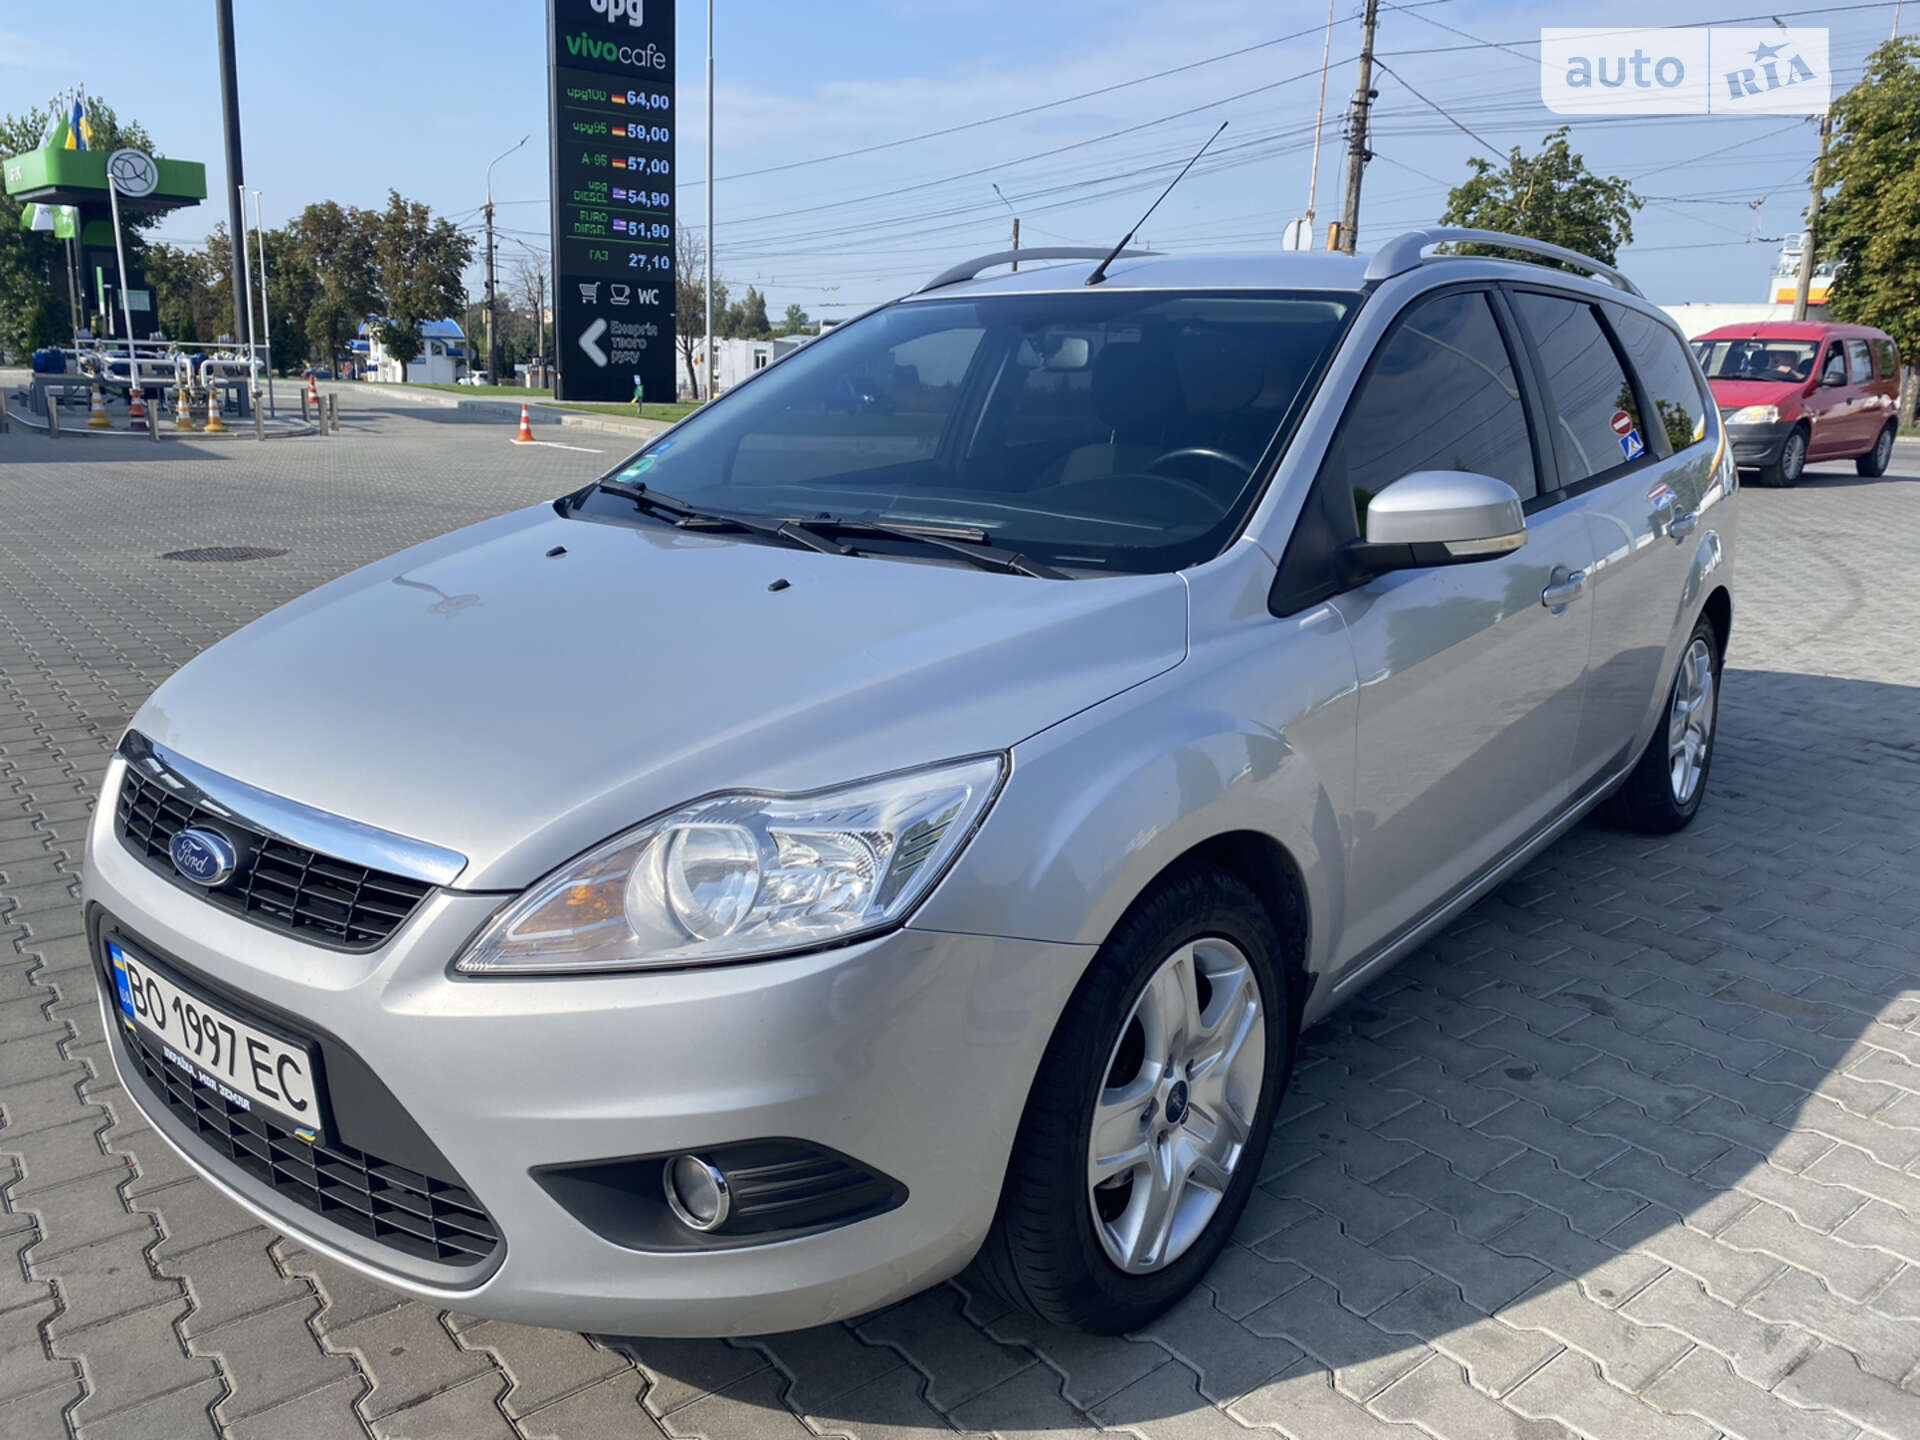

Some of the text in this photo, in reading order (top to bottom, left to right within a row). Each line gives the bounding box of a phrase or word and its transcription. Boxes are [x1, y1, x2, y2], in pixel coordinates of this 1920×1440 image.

[626, 90, 669, 110] 64,00
[627, 123, 669, 142] 59,00
[627, 155, 669, 174] 57,00
[628, 189, 669, 208] 54,90
[628, 221, 670, 239] 51,90
[628, 253, 670, 271] 27,10
[637, 287, 660, 305] WC
[176, 838, 209, 874] Ford
[126, 961, 308, 1113] BO 1997 EC
